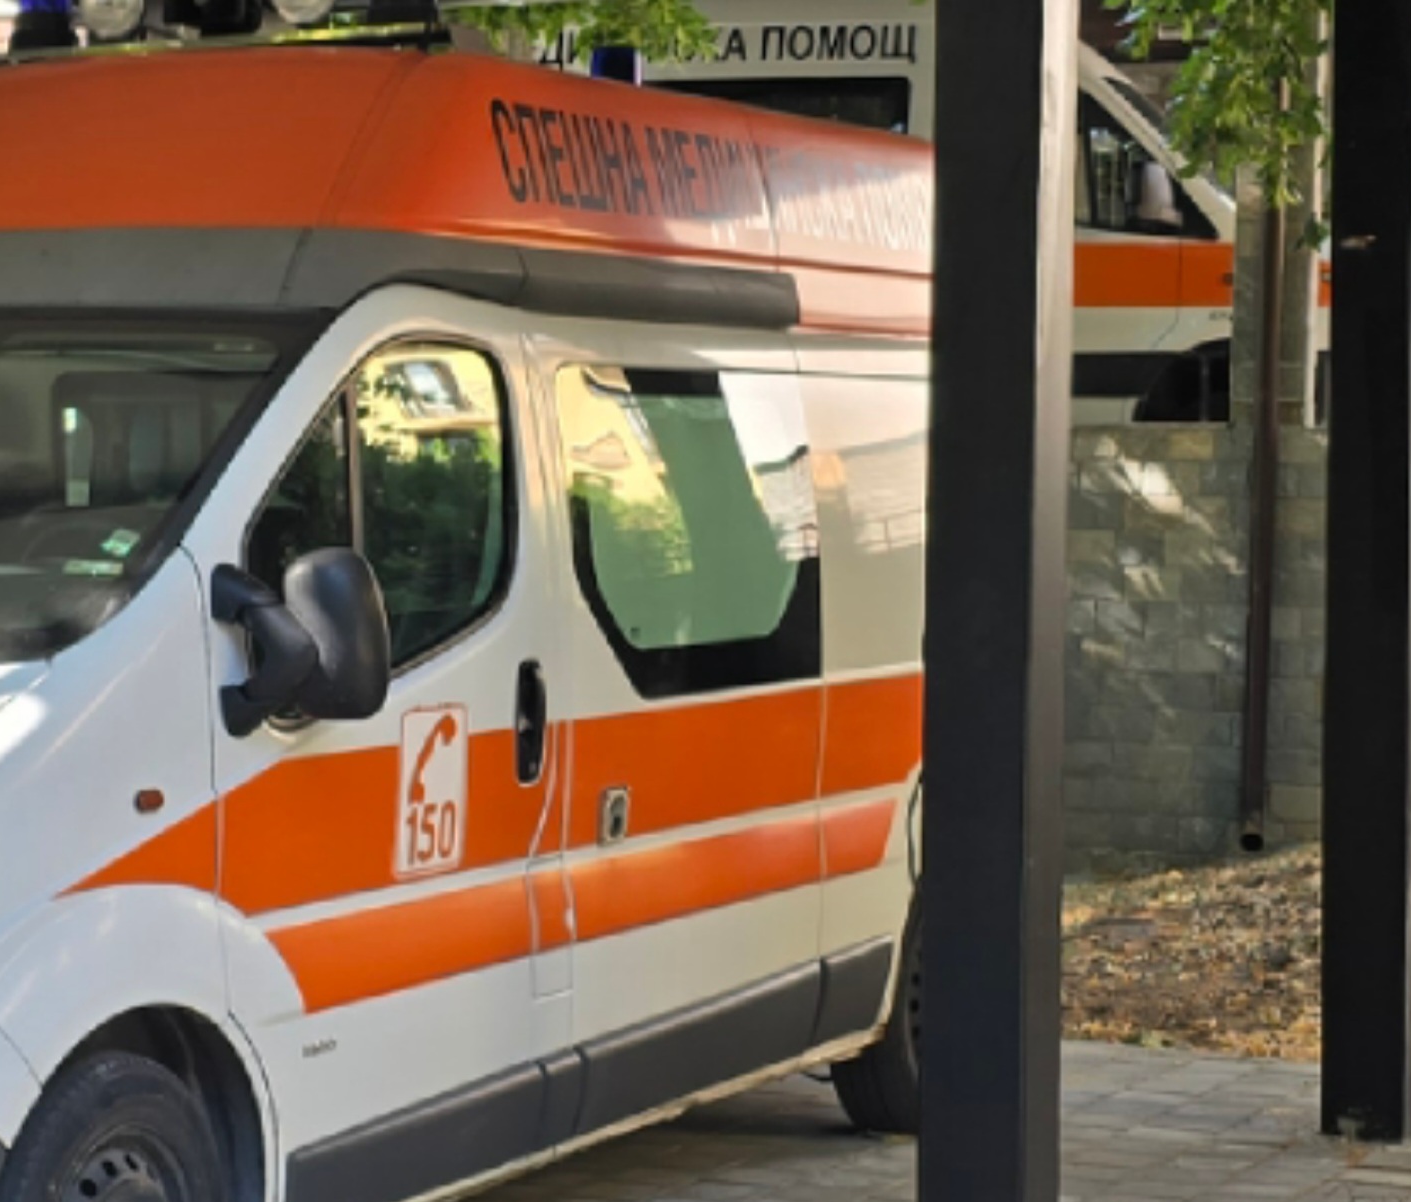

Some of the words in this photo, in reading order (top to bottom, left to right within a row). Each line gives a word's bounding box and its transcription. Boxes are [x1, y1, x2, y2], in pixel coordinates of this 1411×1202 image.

[761, 25, 917, 64] ПОМОЩ
[491, 98, 651, 216] СПЕШНА
[407, 800, 457, 868] 150
